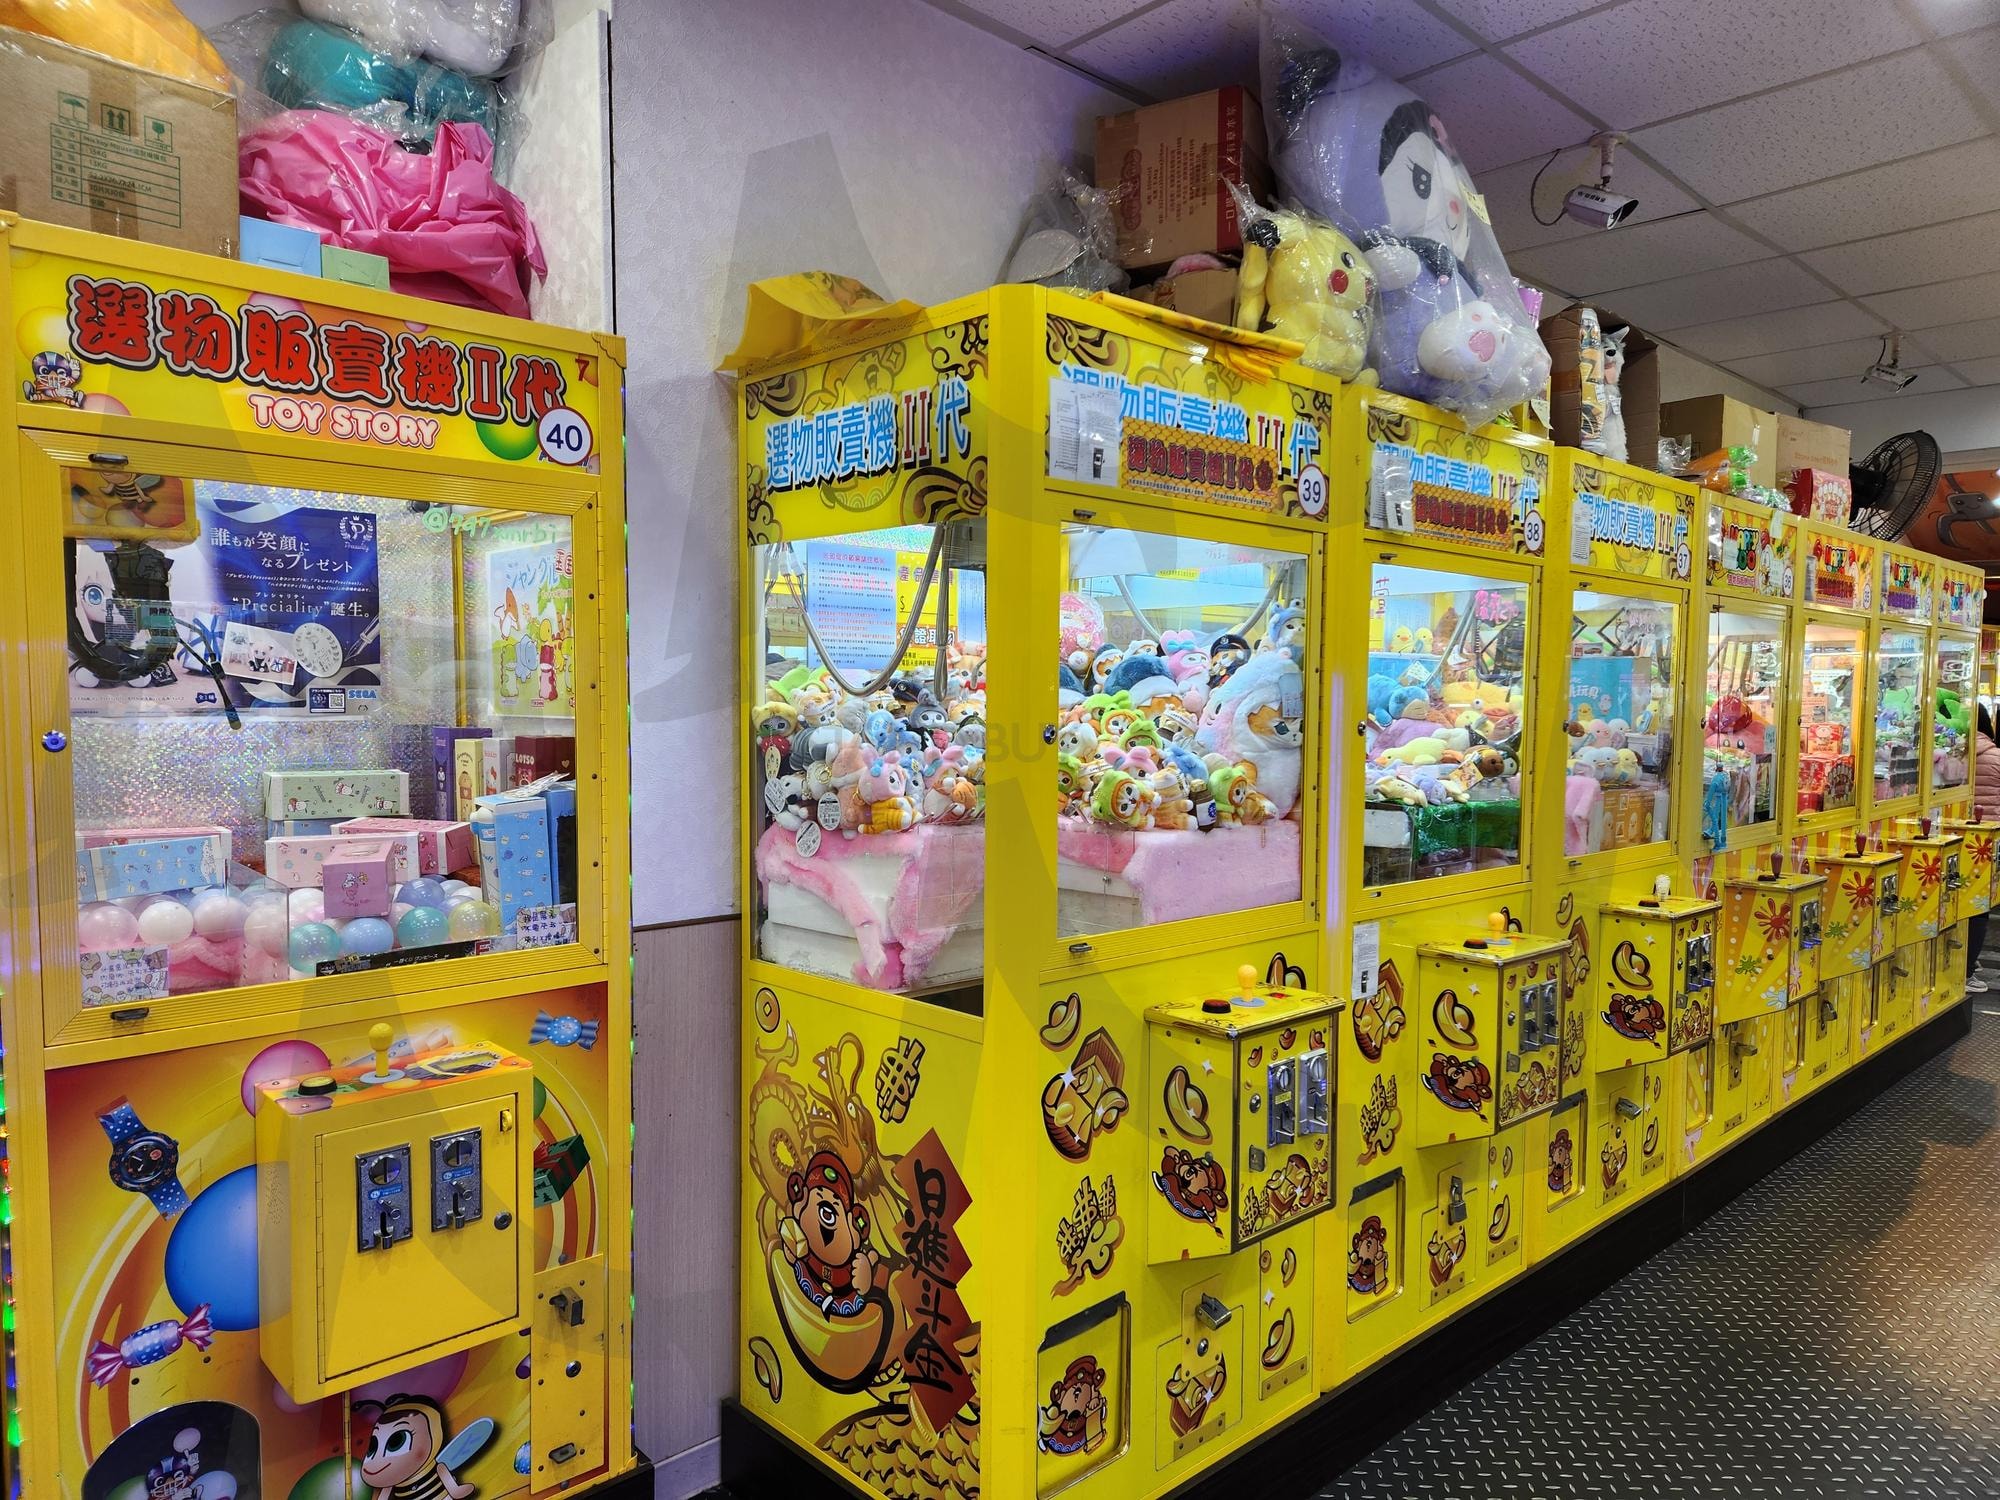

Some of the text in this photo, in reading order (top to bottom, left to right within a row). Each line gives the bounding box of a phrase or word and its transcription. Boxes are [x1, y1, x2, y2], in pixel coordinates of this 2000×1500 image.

[575, 358, 590, 381] 7
[248, 393, 441, 449] TOY STORY
[546, 423, 584, 452] 40
[1303, 477, 1322, 503] 39
[210, 527, 310, 552] 誰もが笑顔に
[1526, 519, 1541, 543] 38
[261, 552, 353, 573] なるプレゼント
[1678, 552, 1689, 570] 37
[348, 689, 377, 699] SEGA
[515, 753, 535, 766] LOTSO
